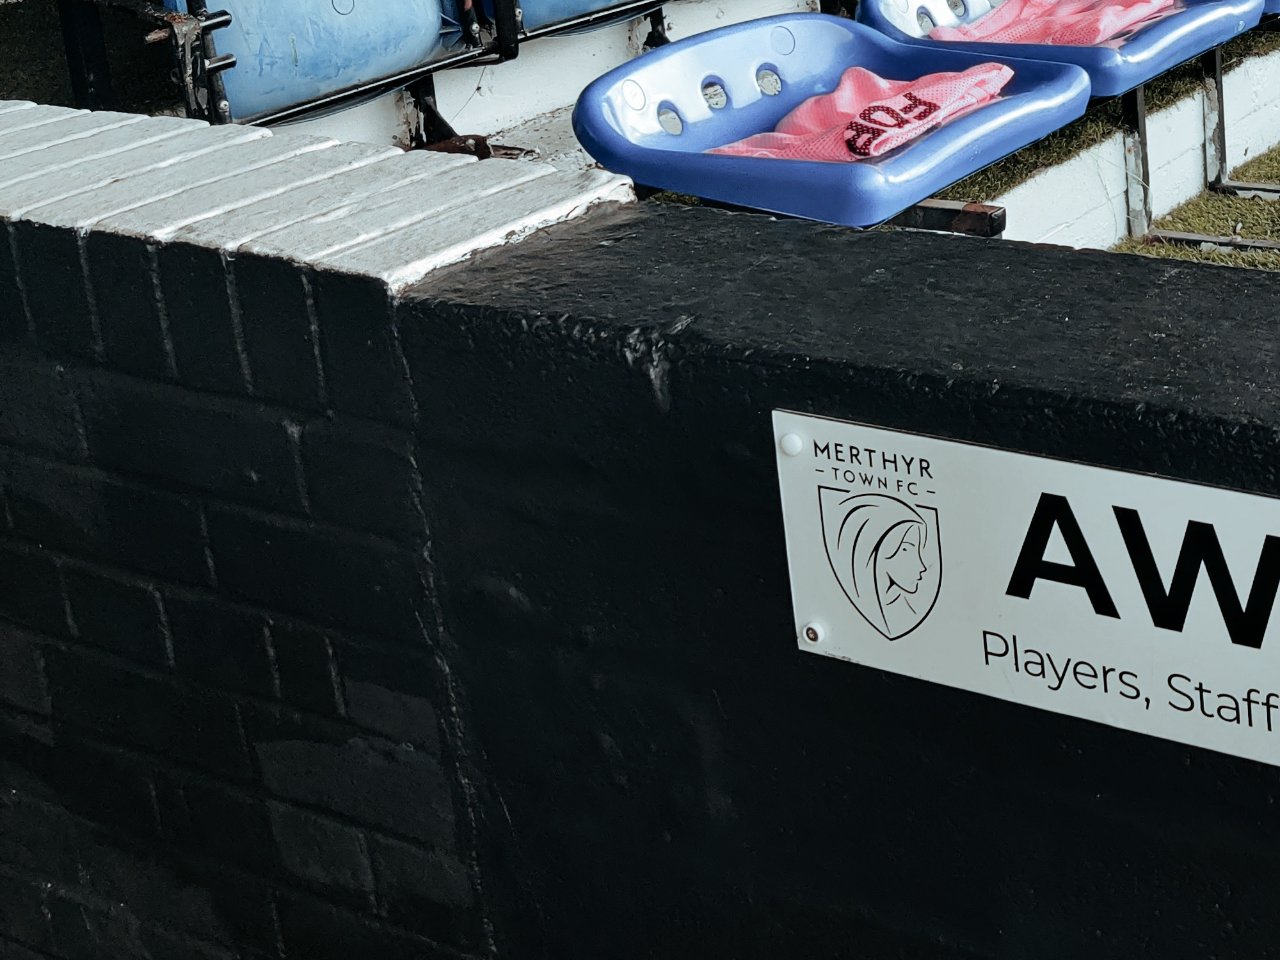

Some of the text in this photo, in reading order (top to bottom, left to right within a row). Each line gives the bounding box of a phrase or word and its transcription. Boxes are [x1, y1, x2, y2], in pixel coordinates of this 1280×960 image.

[813, 439, 934, 480] MERTHYR
[831, 467, 919, 496] TOWN FC
[981, 629, 1151, 711] Players,
[1166, 672, 1280, 732] Staff
